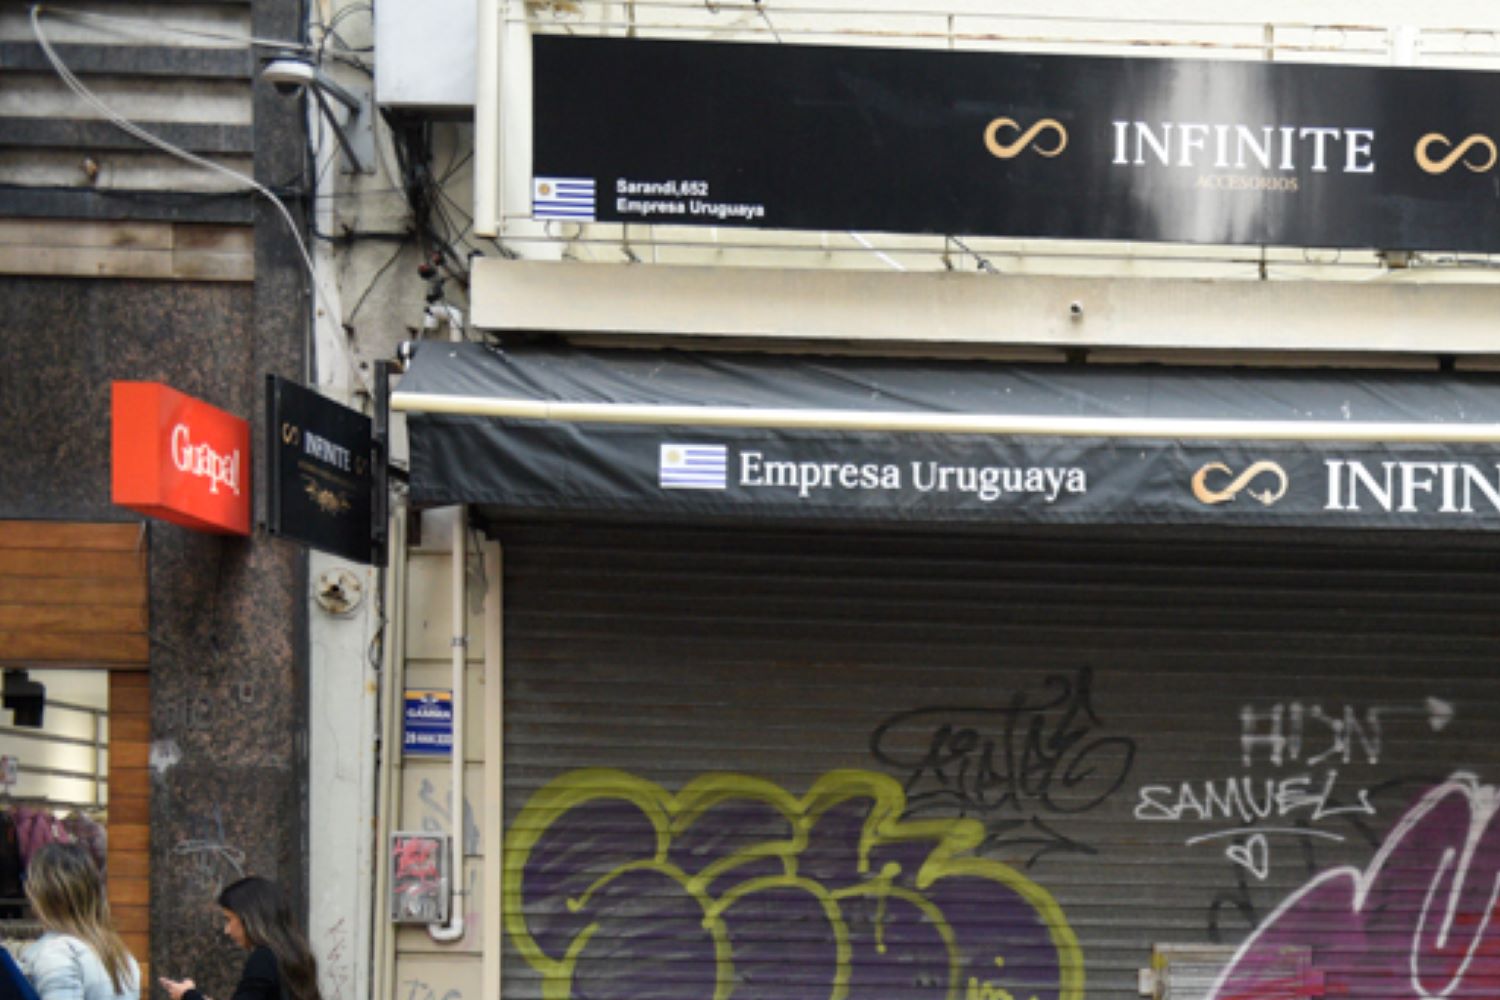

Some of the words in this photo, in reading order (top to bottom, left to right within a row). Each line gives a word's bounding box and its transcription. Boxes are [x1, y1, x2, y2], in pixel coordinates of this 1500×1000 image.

[1112, 121, 1375, 173] INFINITE
[615, 198, 685, 216] Empresa
[690, 200, 765, 219] Uruguaya
[303, 430, 351, 472] INFINITE
[738, 451, 901, 498] Empresa
[911, 461, 1087, 501] Uruguaya
[1133, 769, 1376, 823] SAMUEL
